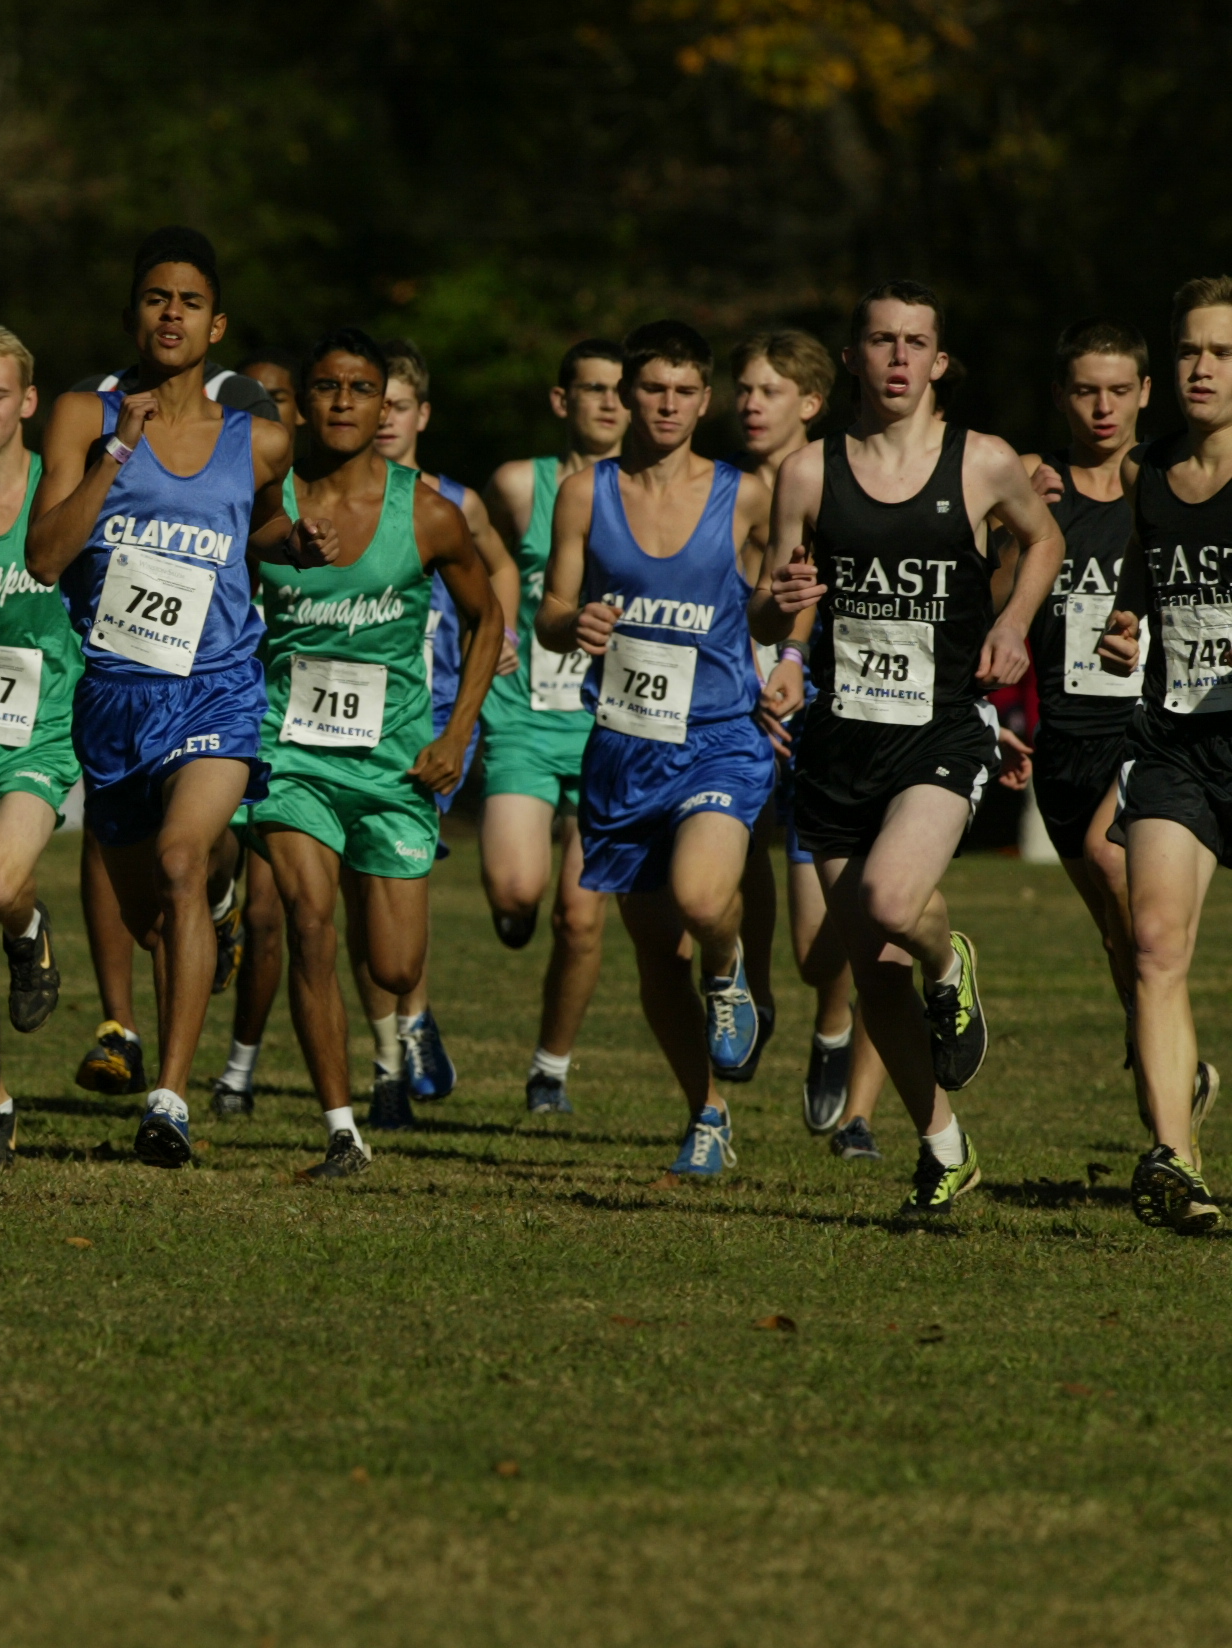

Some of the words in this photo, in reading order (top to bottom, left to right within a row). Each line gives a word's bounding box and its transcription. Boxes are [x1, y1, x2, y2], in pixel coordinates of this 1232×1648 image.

[103, 514, 232, 561] CLAYTON
[831, 556, 957, 598] EAST
[125, 585, 182, 627] 728
[834, 593, 901, 619] chapel
[908, 599, 947, 622] hill
[103, 613, 126, 628] M-F
[127, 624, 191, 650] ATHLETIC
[858, 650, 909, 682] 743
[1073, 661, 1095, 671] M-F
[1184, 637, 1232, 670] 742
[623, 667, 668, 701] 729
[840, 683, 862, 694] M-F
[865, 687, 926, 701] ATHLETIC
[311, 687, 360, 720] 719
[605, 696, 625, 708] M-F
[627, 702, 681, 720] ATHLETIC
[292, 717, 314, 728] M-F
[317, 722, 374, 738] ATHLETIC
